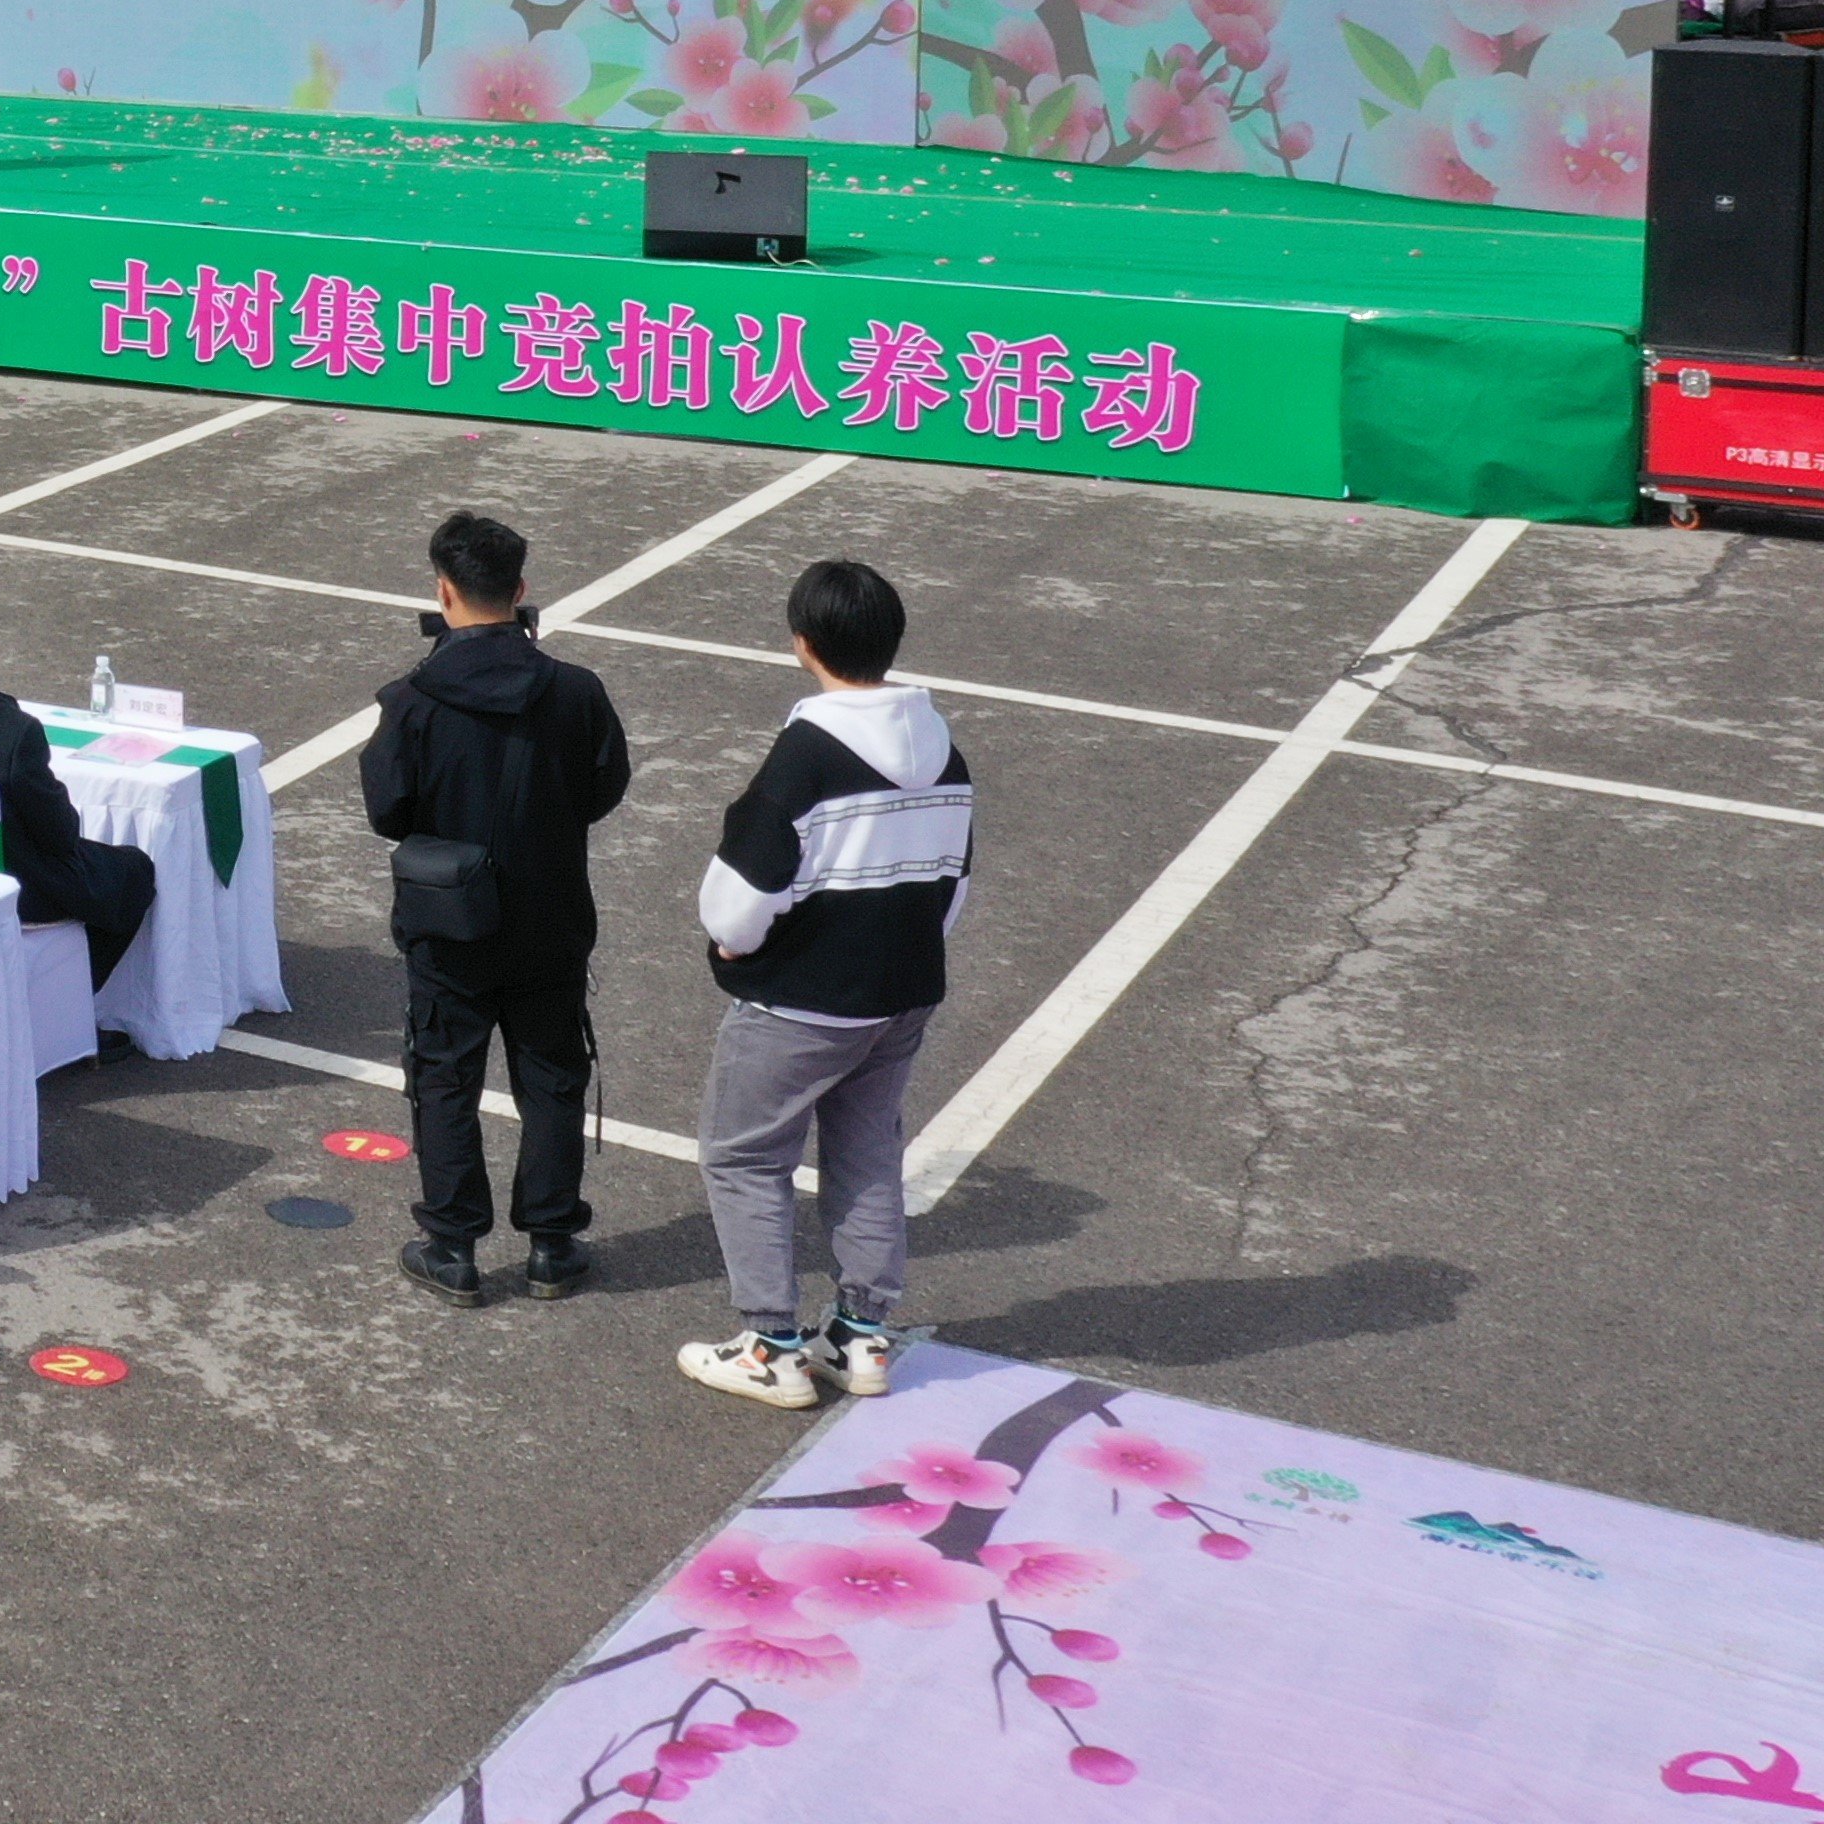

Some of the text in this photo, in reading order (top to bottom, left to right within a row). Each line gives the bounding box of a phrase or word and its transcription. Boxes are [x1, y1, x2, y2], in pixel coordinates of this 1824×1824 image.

[90, 257, 1202, 454] 古树集中竞拍认养活动
